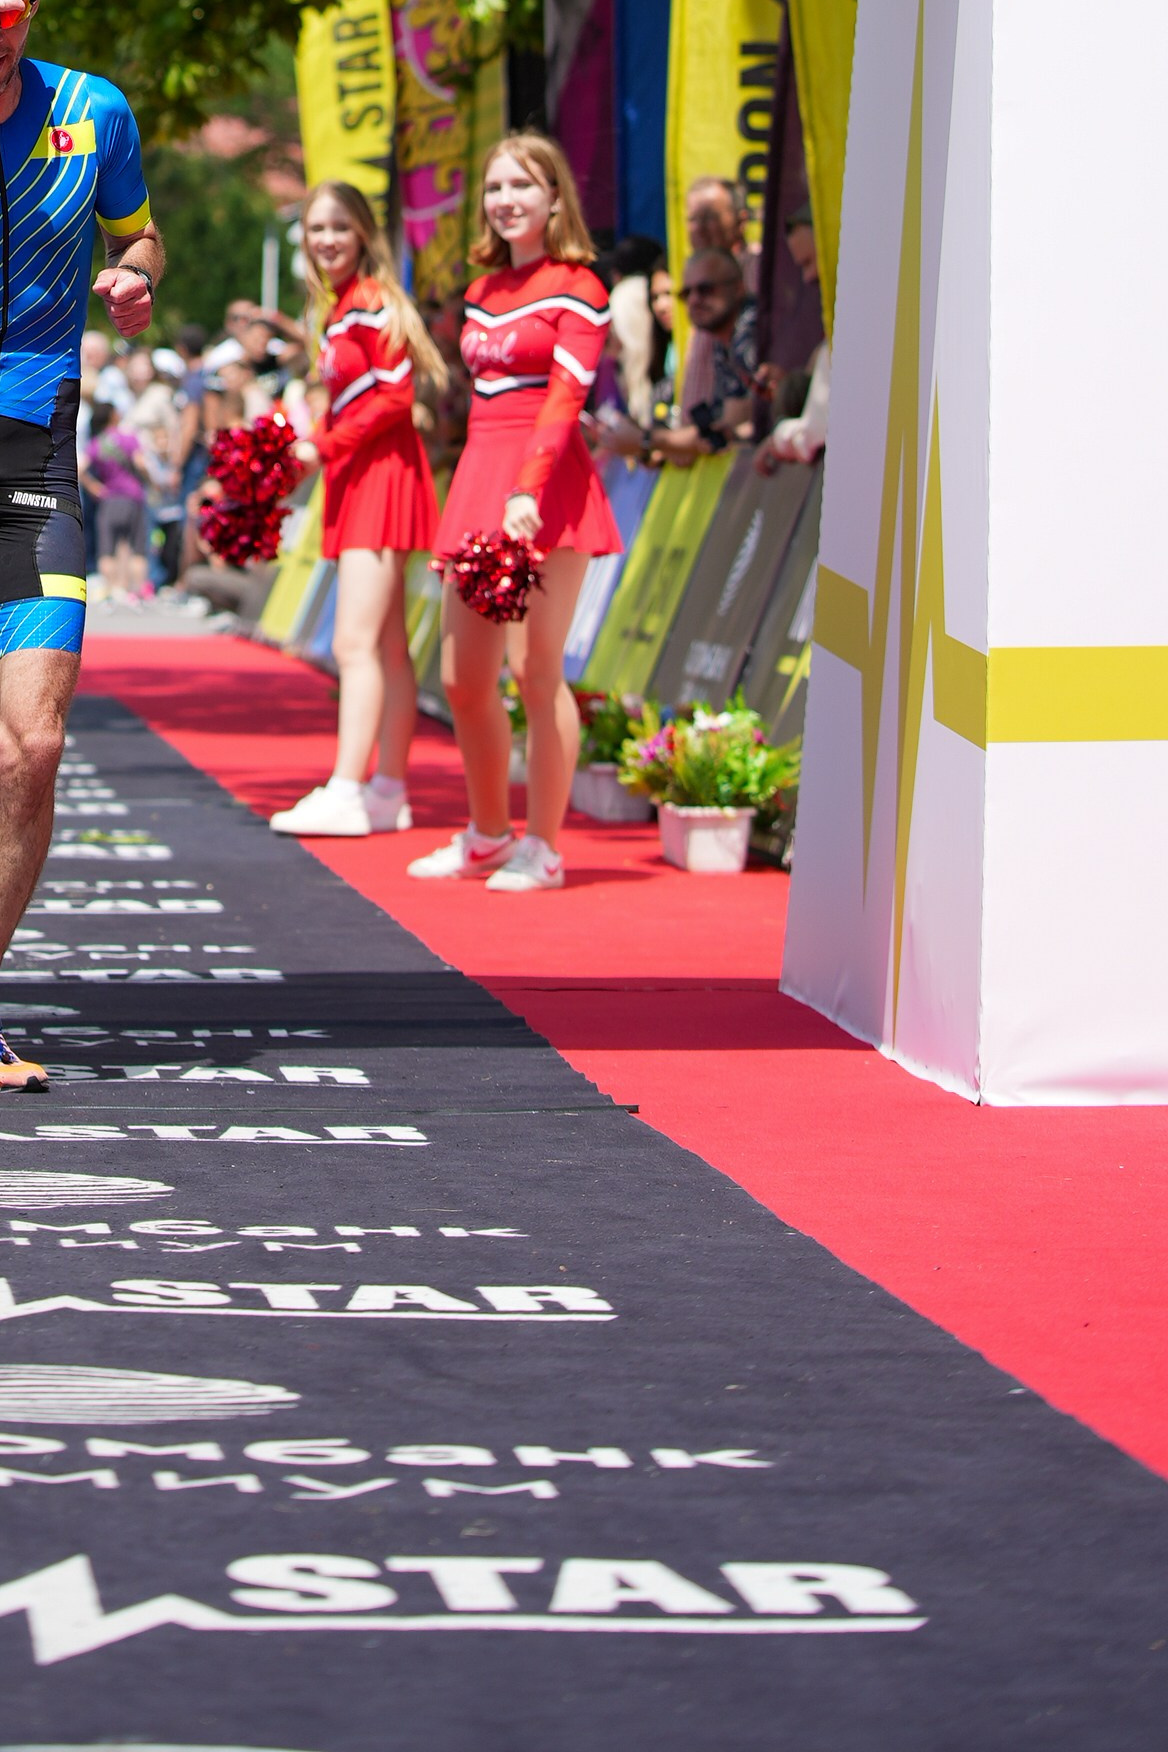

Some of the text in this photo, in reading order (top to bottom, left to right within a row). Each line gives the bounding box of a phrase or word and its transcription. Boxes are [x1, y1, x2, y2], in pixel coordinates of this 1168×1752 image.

[334, 11, 383, 131] STAR
[12, 491, 58, 510] IRONSTAR
[34, 1124, 430, 1142] STAR
[110, 1278, 615, 1312] STAR
[225, 1553, 921, 1614] STAR
